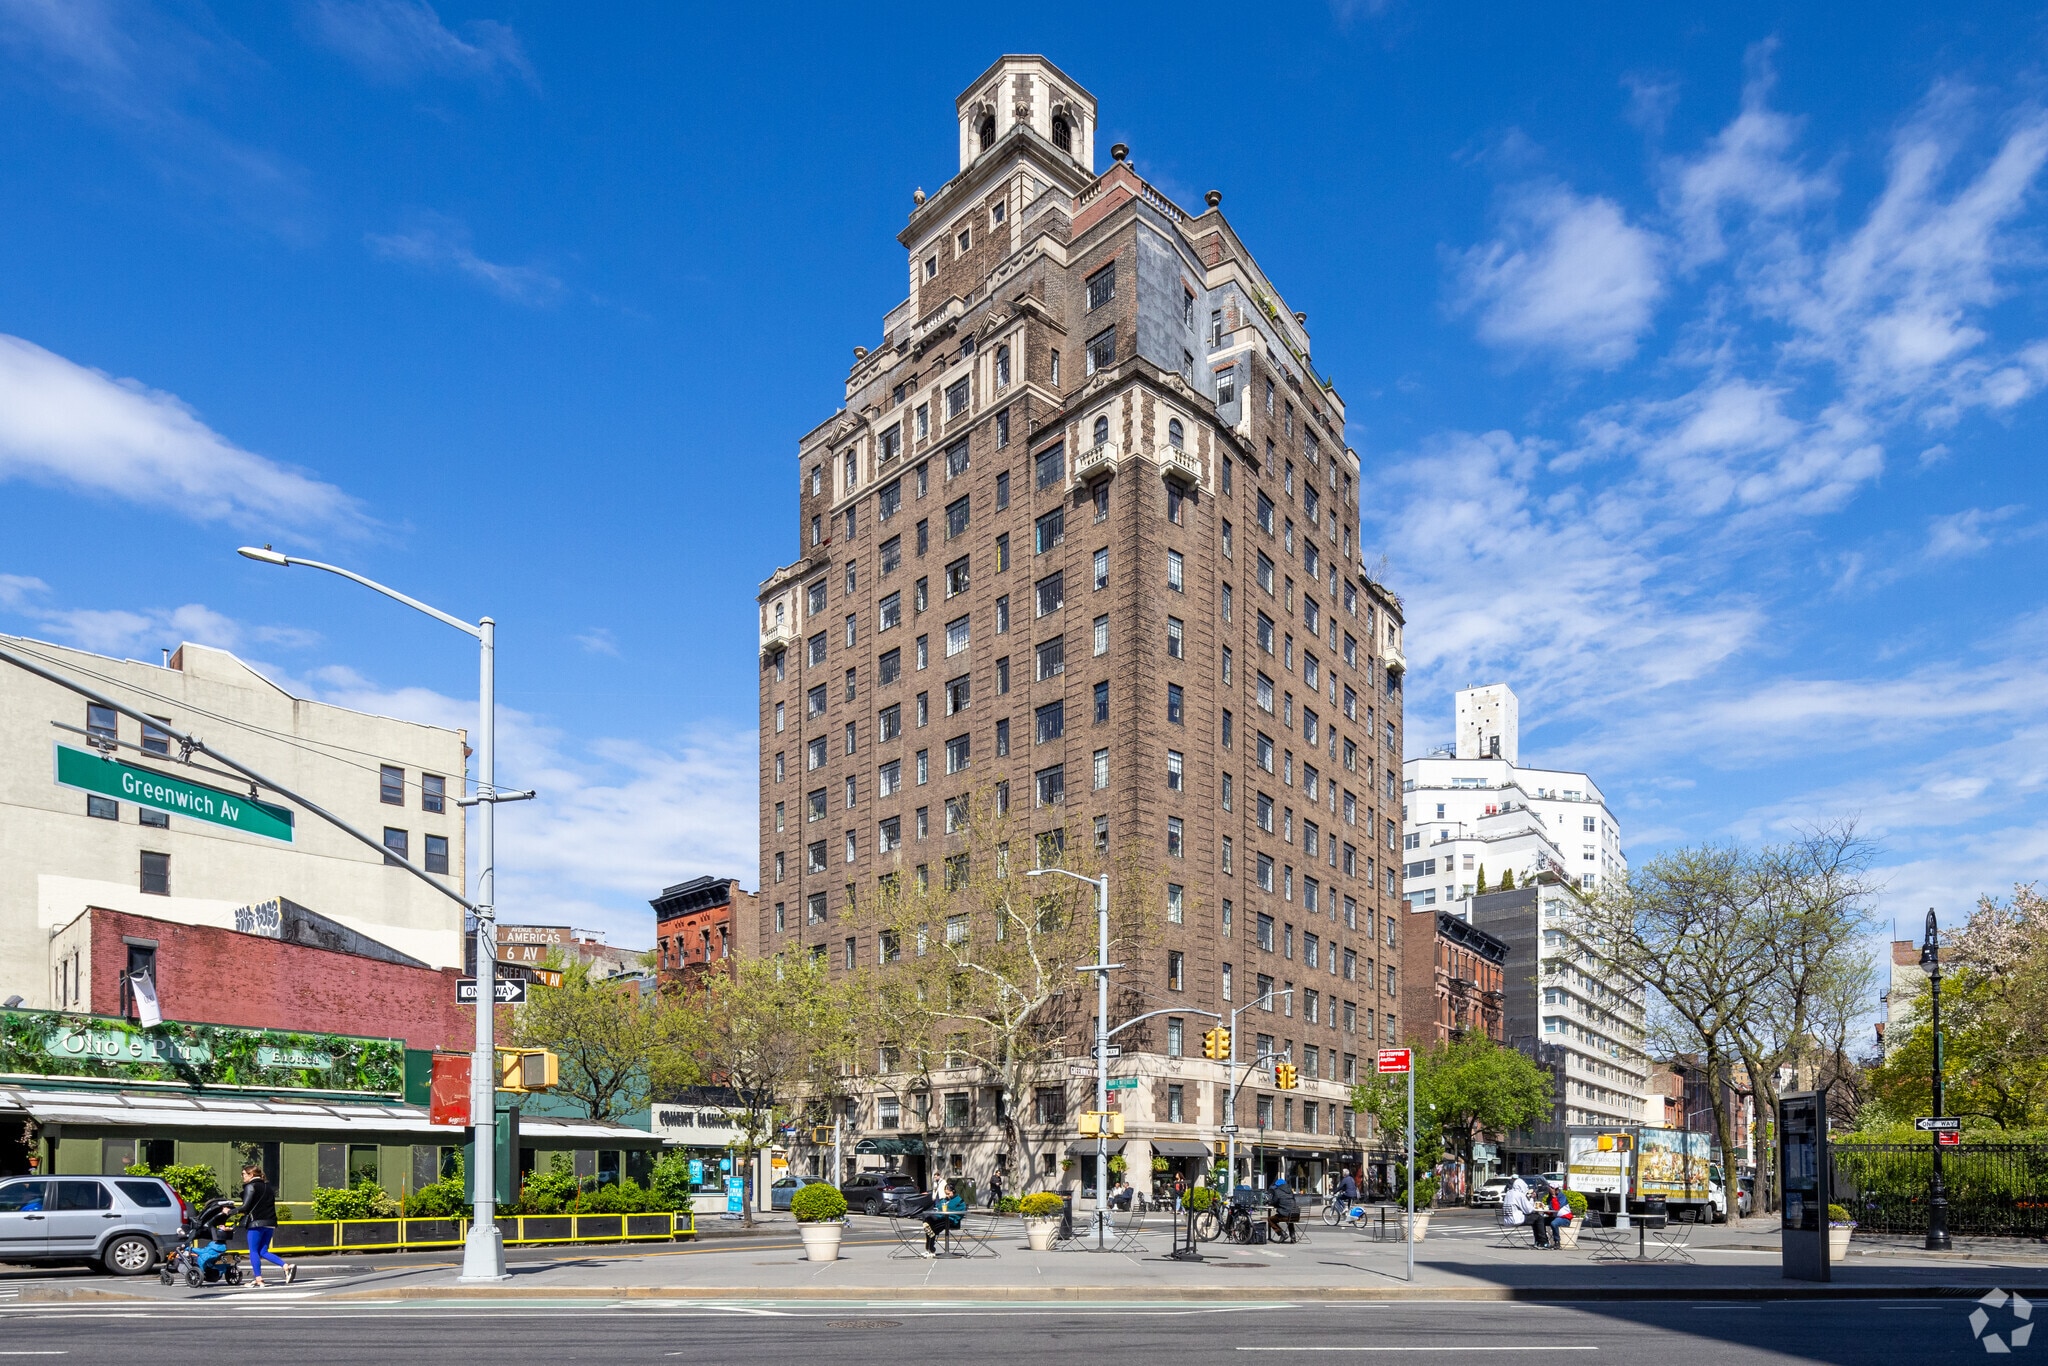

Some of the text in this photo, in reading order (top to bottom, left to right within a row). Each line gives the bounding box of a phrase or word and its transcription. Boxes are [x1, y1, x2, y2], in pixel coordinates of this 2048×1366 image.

[122, 772, 240, 822] Greenwich Av
[506, 932, 561, 943] AMERICAS
[506, 946, 538, 961] 6 AV
[497, 965, 560, 987] GREENWICH AV
[466, 986, 515, 997] ON WAY
[63, 1032, 120, 1056] Olio
[129, 1041, 143, 1058] e
[272, 1052, 320, 1065] Enoteca
